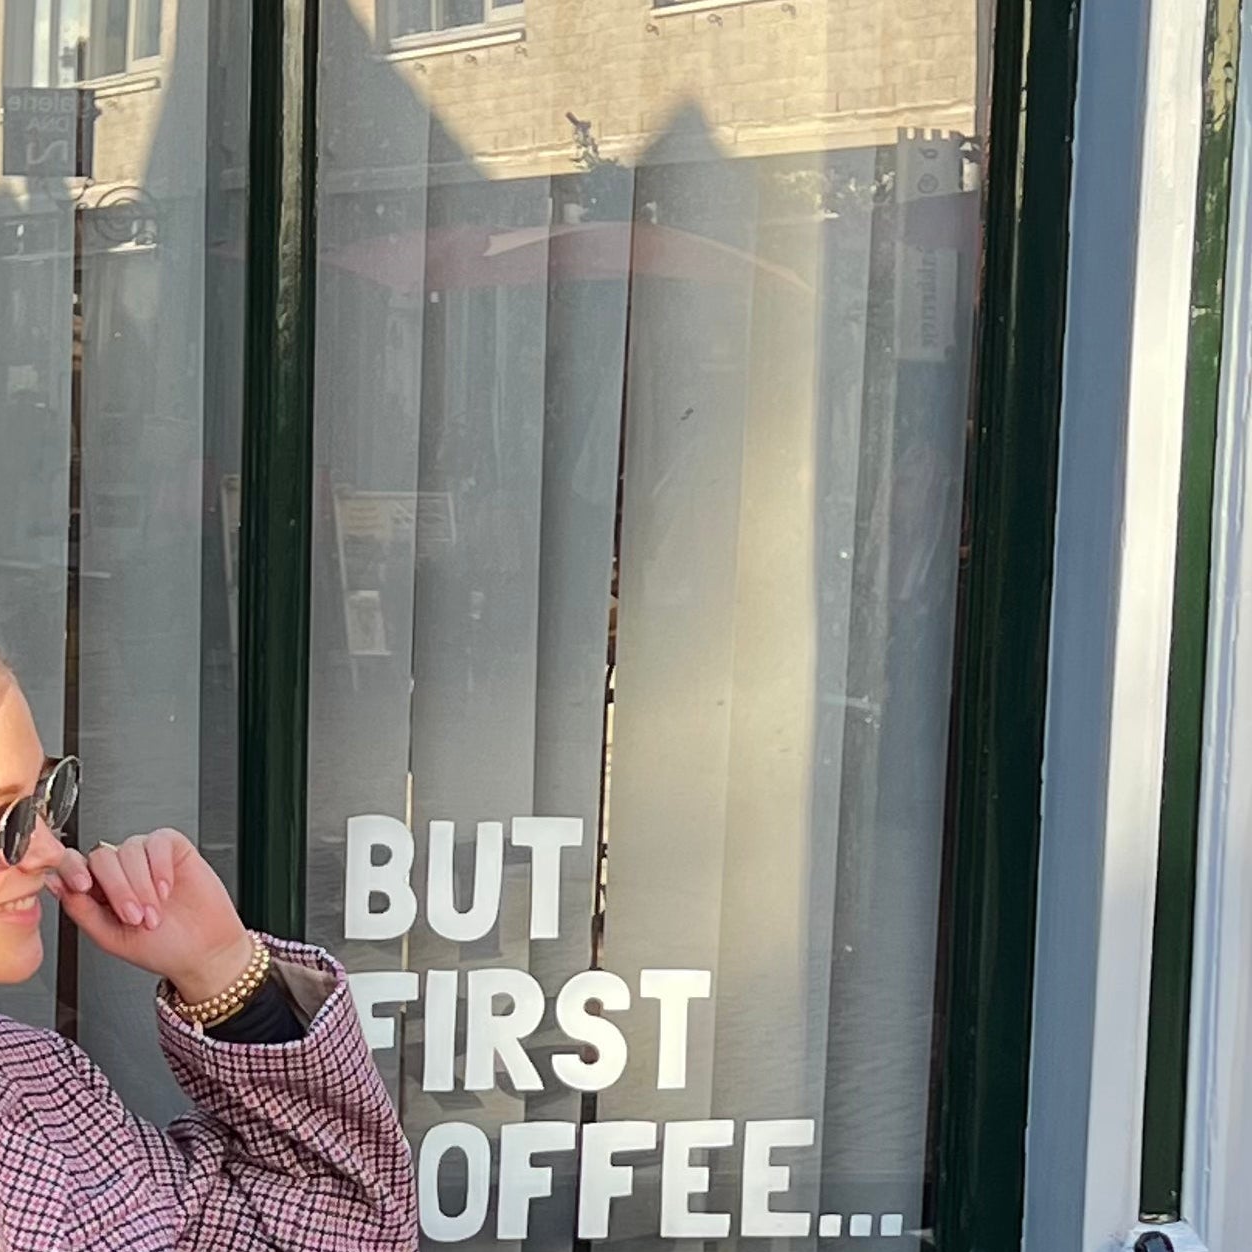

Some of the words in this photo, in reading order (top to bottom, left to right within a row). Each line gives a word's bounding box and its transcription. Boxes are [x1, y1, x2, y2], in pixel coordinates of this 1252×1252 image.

[345, 814, 584, 942] BUT
[348, 968, 711, 1092] FIRST
[418, 1119, 903, 1242] OFFEE...
